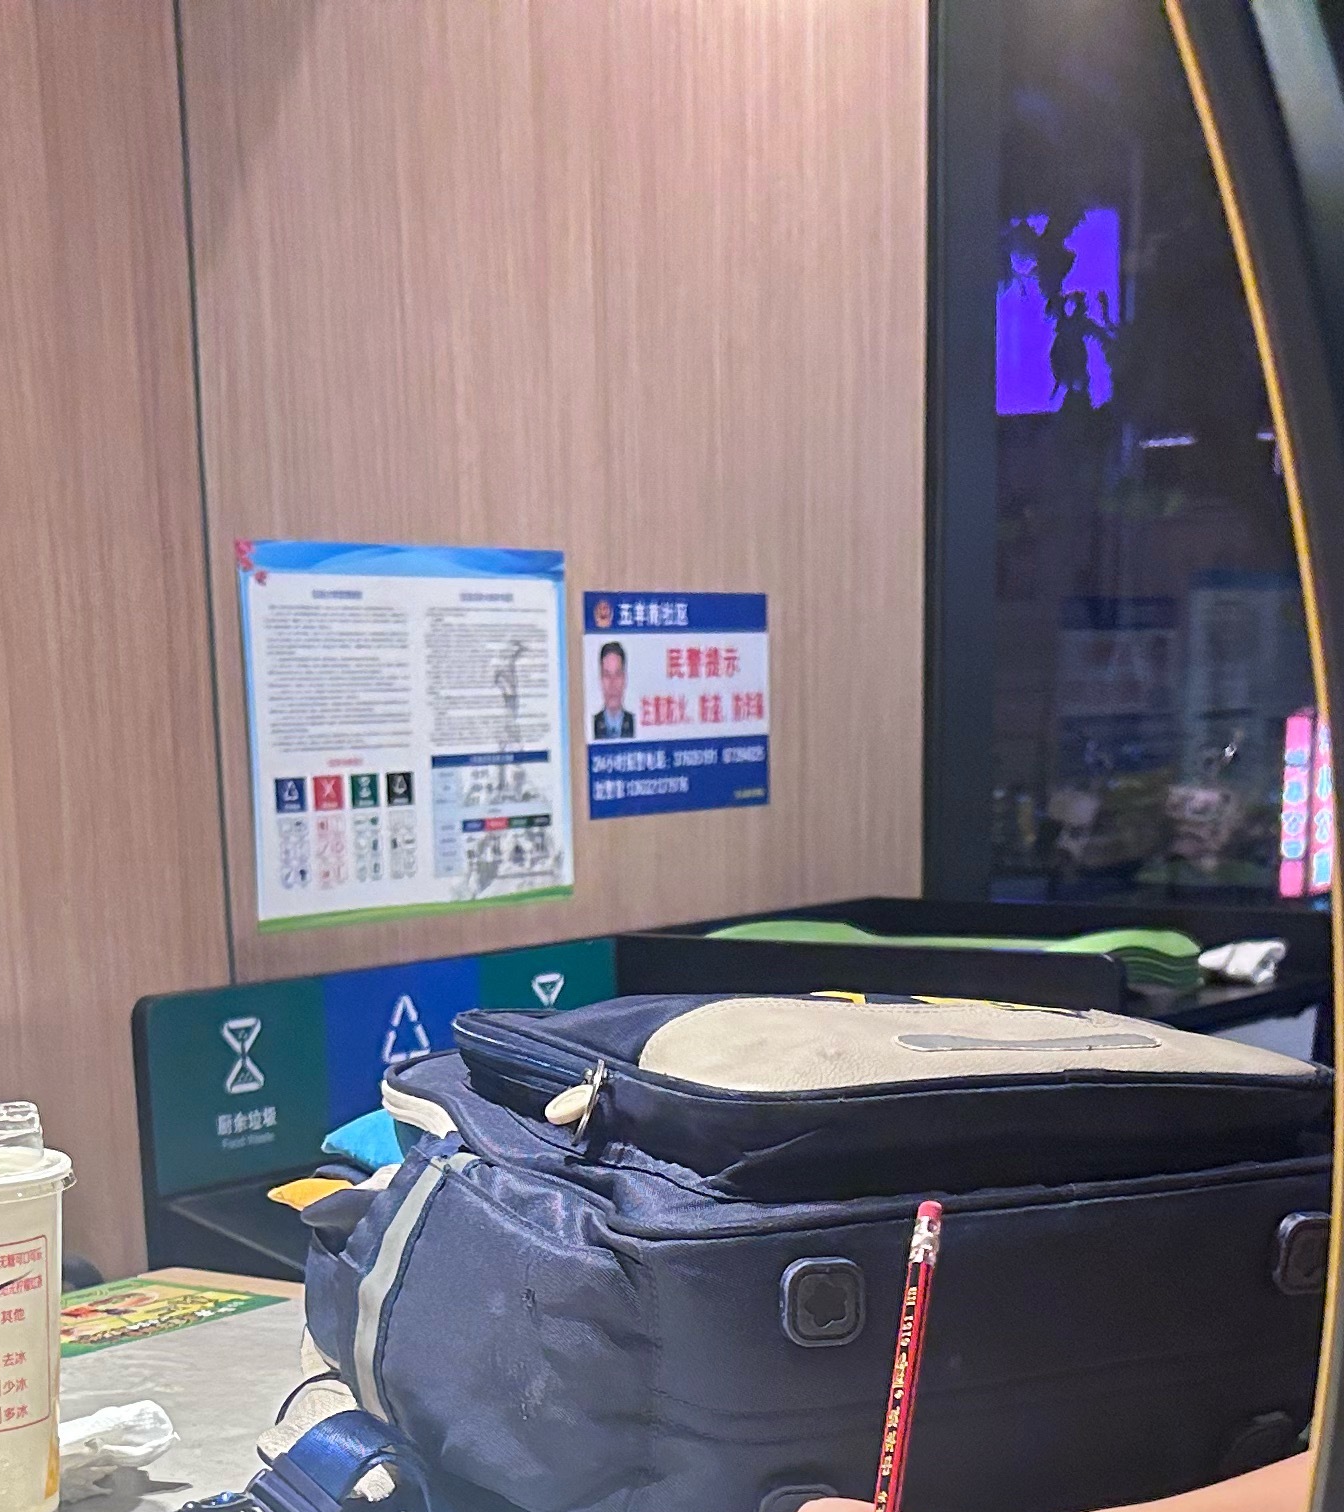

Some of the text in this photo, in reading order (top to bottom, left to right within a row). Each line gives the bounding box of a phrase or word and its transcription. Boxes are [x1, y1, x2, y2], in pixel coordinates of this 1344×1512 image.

[1, 1308, 25, 1324] 其他
[3, 1352, 27, 1368] 去冰
[3, 1378, 27, 1395] 少冰
[4, 1404, 28, 1421] 多冰
